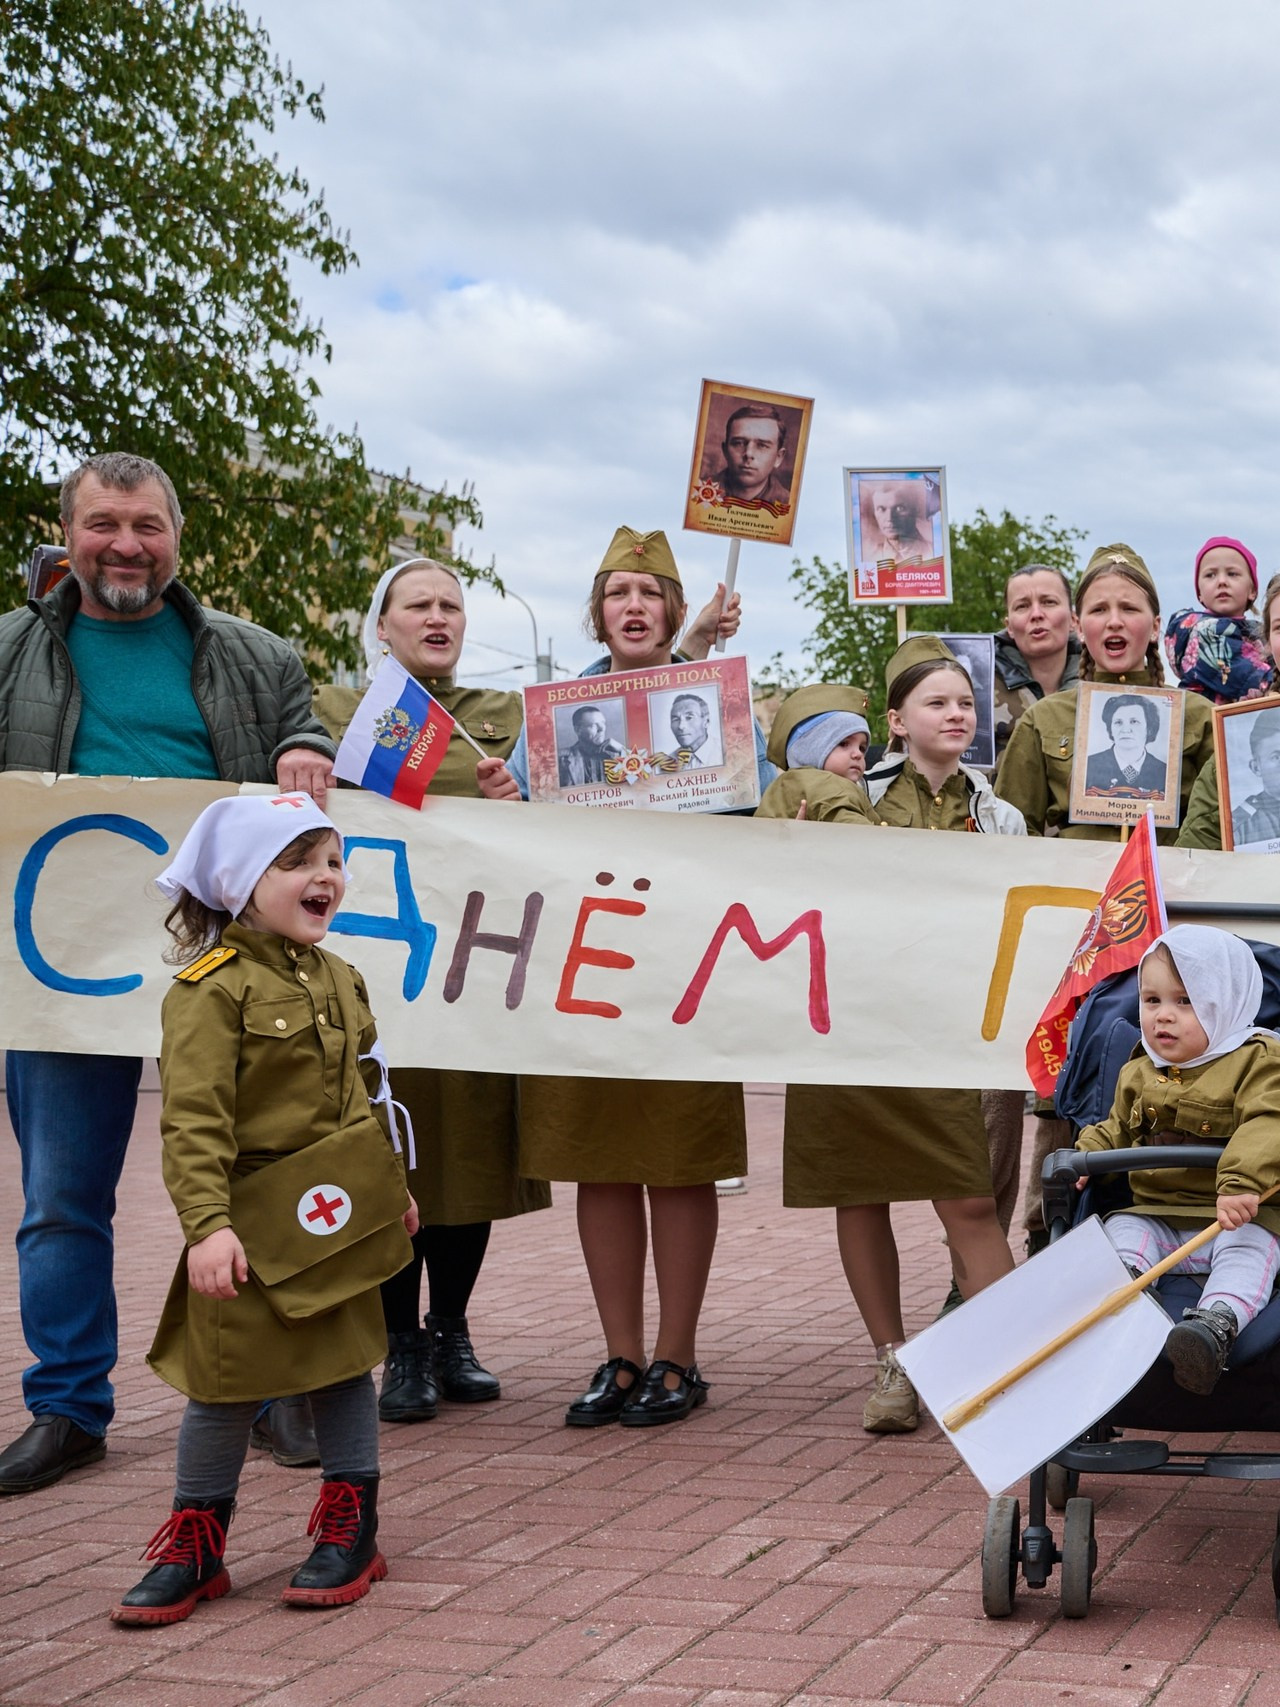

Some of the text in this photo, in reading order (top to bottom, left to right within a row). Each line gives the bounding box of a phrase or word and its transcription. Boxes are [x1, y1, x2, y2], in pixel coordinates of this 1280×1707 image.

[896, 572, 940, 581] БЕЛЯКОВ
[547, 666, 723, 703] БЕССМЕРТНЫЙ ПОЛК
[666, 773, 718, 789] САЖНЕВ
[567, 787, 622, 804] ОСЕТРОВ
[649, 784, 737, 803] Василий Иванович
[678, 798, 710, 811] рядовой
[1107, 801, 1137, 810] Мороз
[1075, 809, 1171, 820] Мильдред Ивавна
[14, 813, 169, 996] С
[1036, 1026, 1063, 1076] 1945
